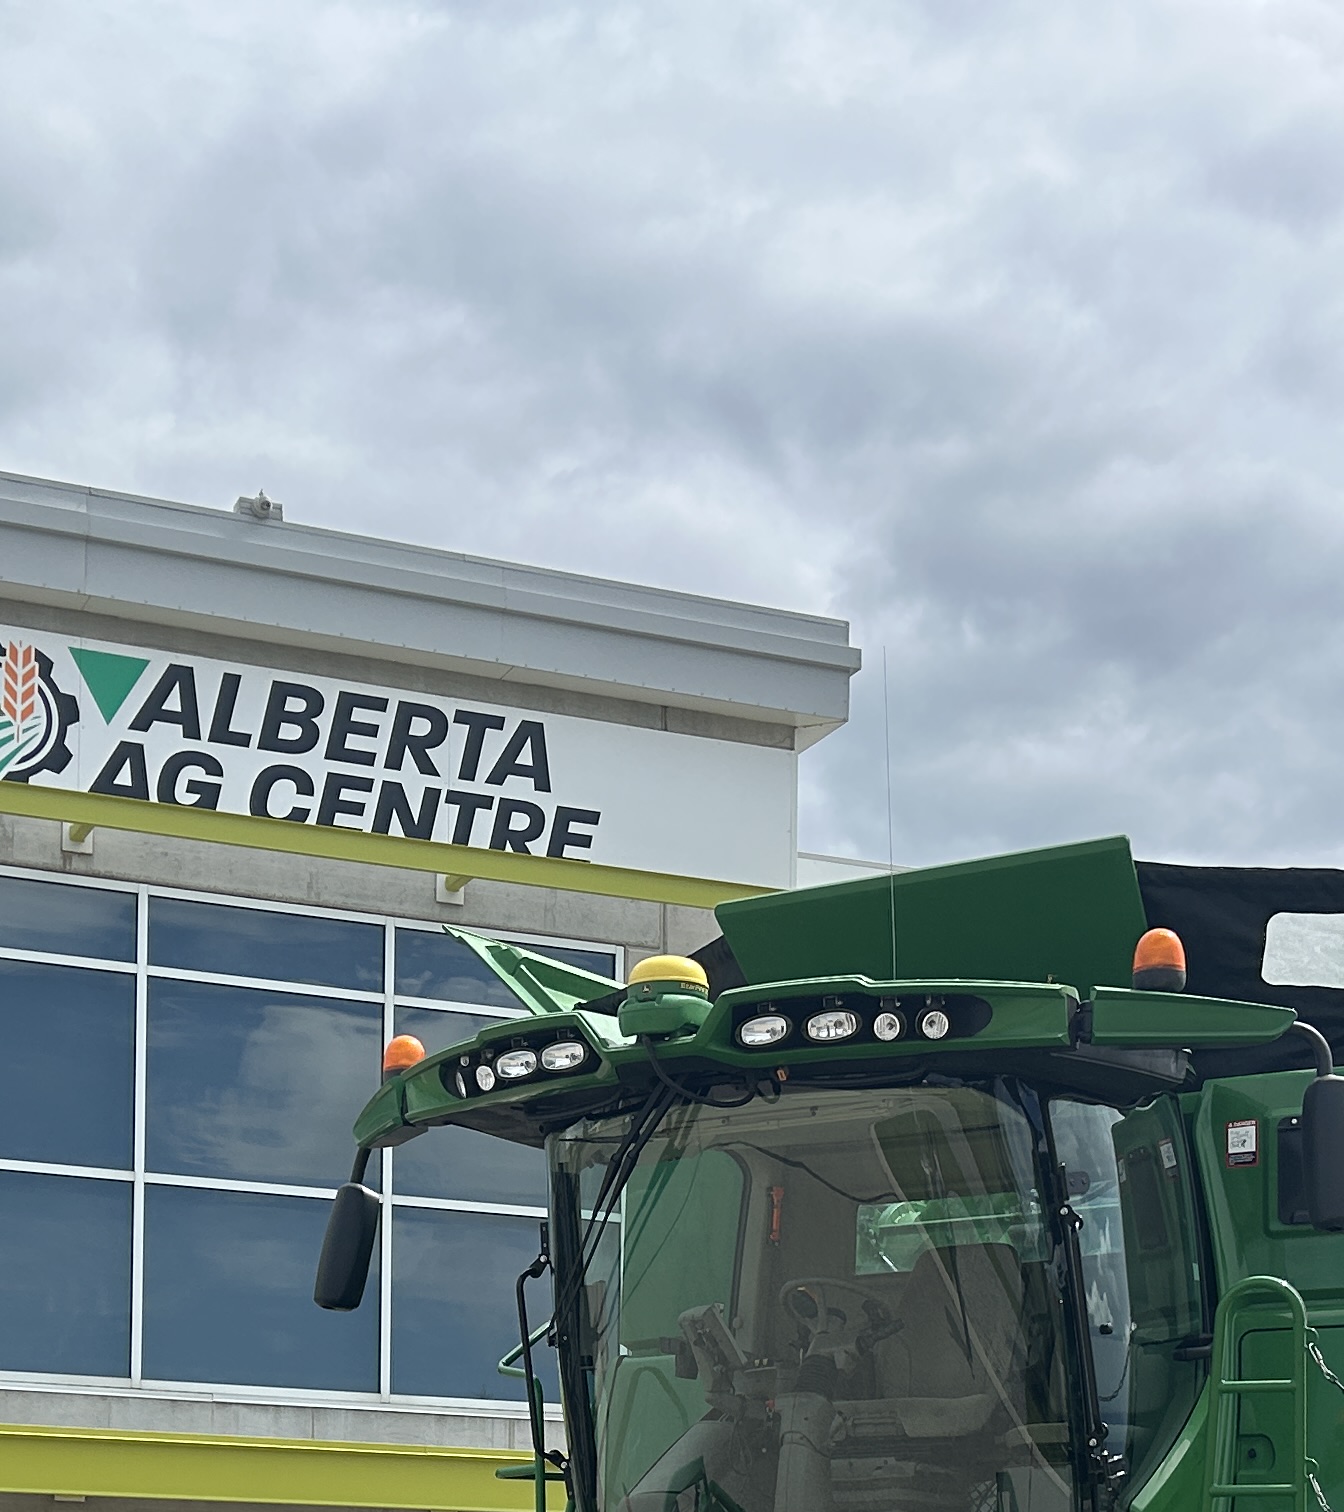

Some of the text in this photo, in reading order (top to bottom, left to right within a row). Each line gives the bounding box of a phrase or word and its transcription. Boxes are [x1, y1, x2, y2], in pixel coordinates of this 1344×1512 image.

[127, 664, 553, 793] ALBERTA
[87, 740, 602, 865] AG CENTRE
